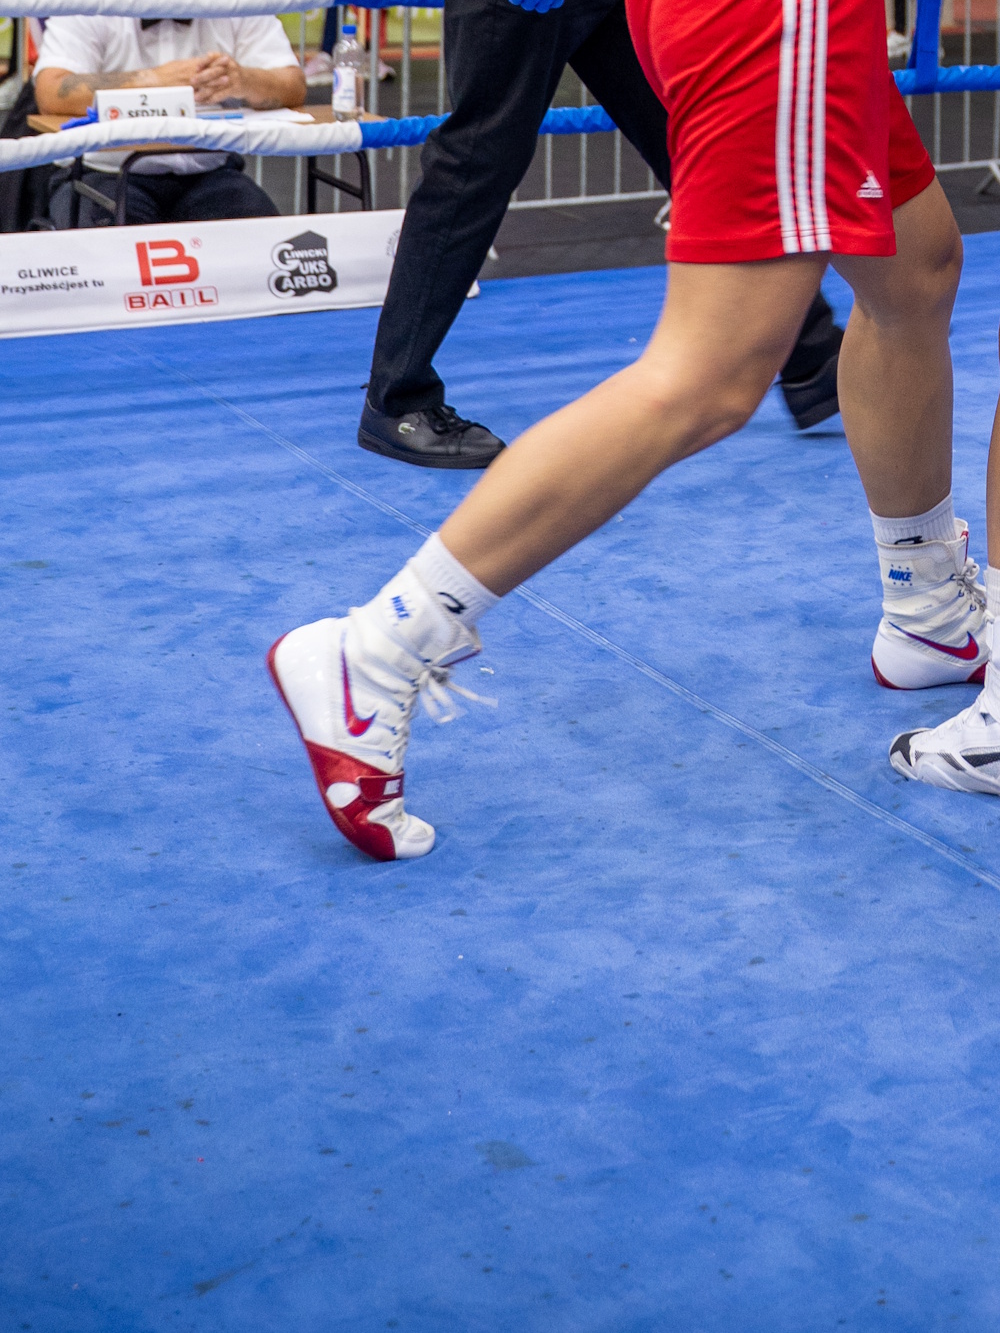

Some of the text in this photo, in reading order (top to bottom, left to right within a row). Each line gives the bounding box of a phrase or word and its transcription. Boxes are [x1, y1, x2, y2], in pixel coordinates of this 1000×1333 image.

[140, 93, 148, 106] 2
[17, 265, 79, 279] GLIWICE
[299, 259, 328, 275] UKS
[92, 279, 105, 288] tu
[268, 269, 333, 299] CARBO
[127, 289, 215, 309] BAIL
[888, 568, 914, 582] NIKE
